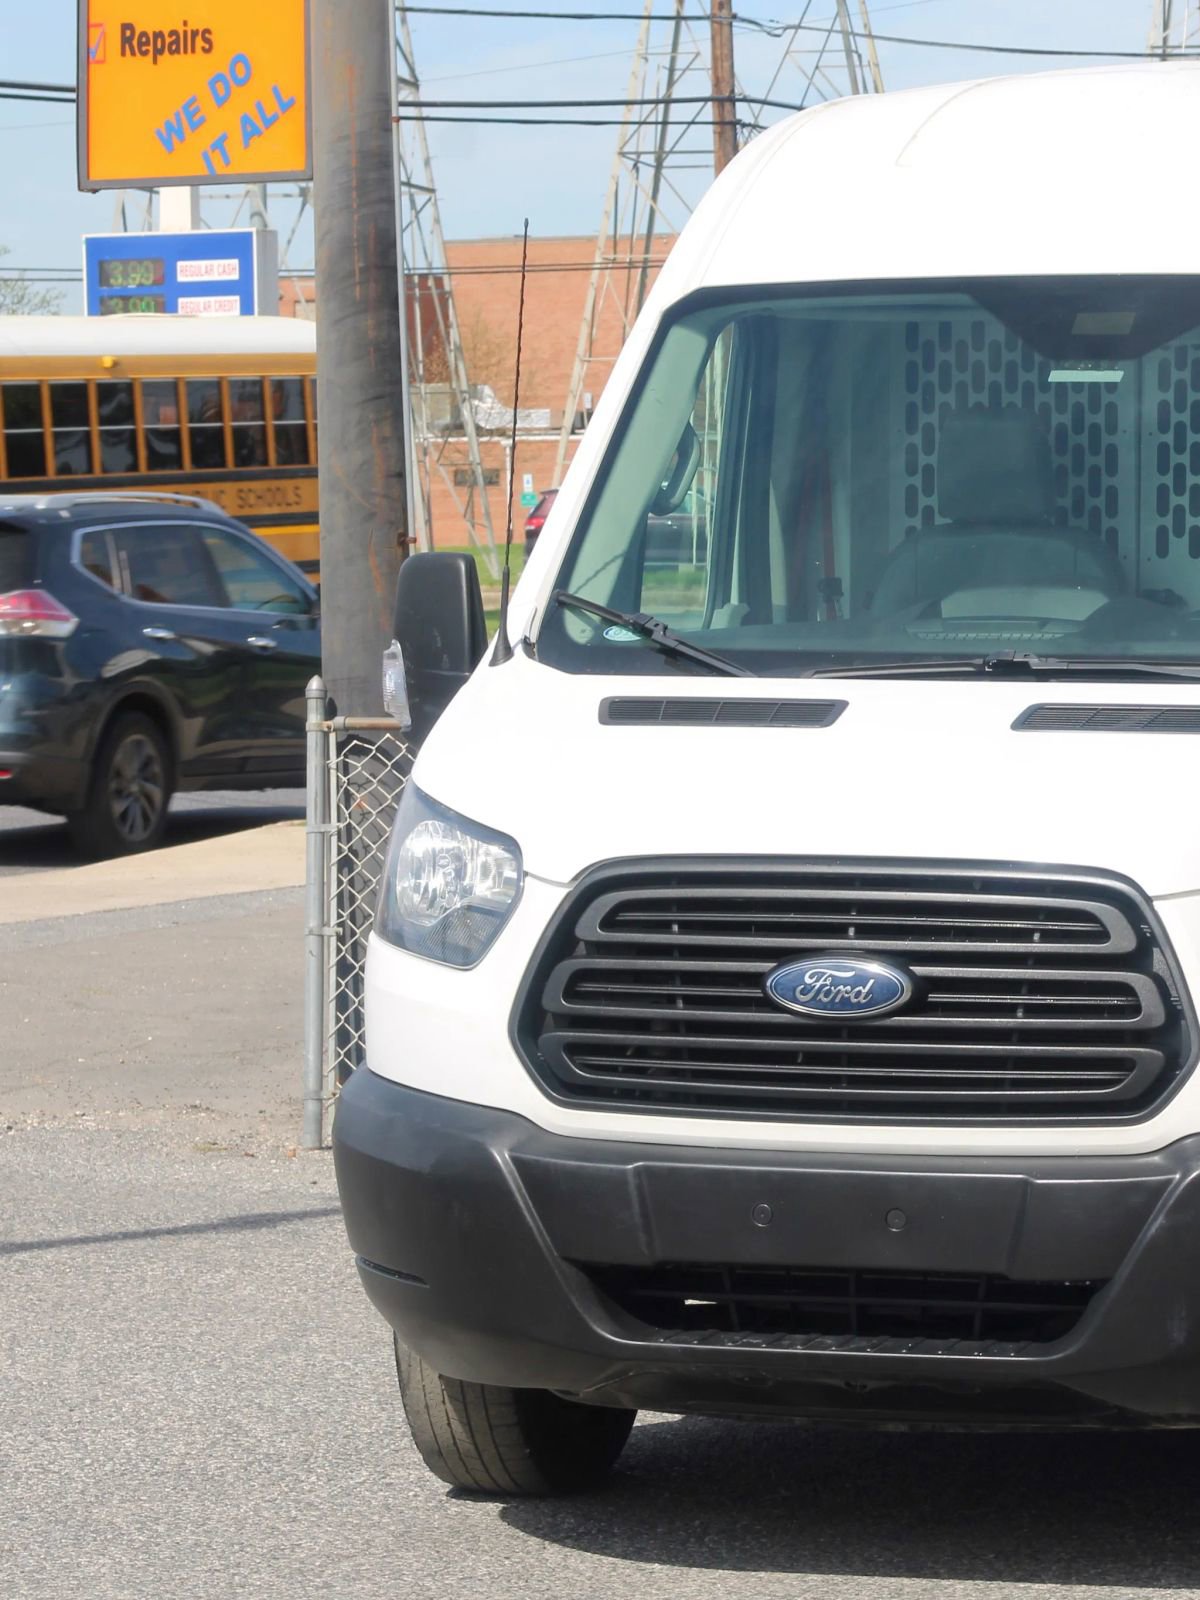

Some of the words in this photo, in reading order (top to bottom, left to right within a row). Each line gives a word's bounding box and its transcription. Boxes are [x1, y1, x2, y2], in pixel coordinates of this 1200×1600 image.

[120, 20, 213, 65] Repairs
[154, 95, 206, 154] WE
[207, 52, 252, 108] DO
[201, 132, 231, 176] IT
[239, 84, 296, 149] ALL
[179, 263, 214, 278] REGULAR
[217, 261, 237, 277] CASH
[180, 299, 212, 316] REGULAR
[237, 485, 301, 509] SCHOOLS
[795, 968, 875, 1004] Ford
